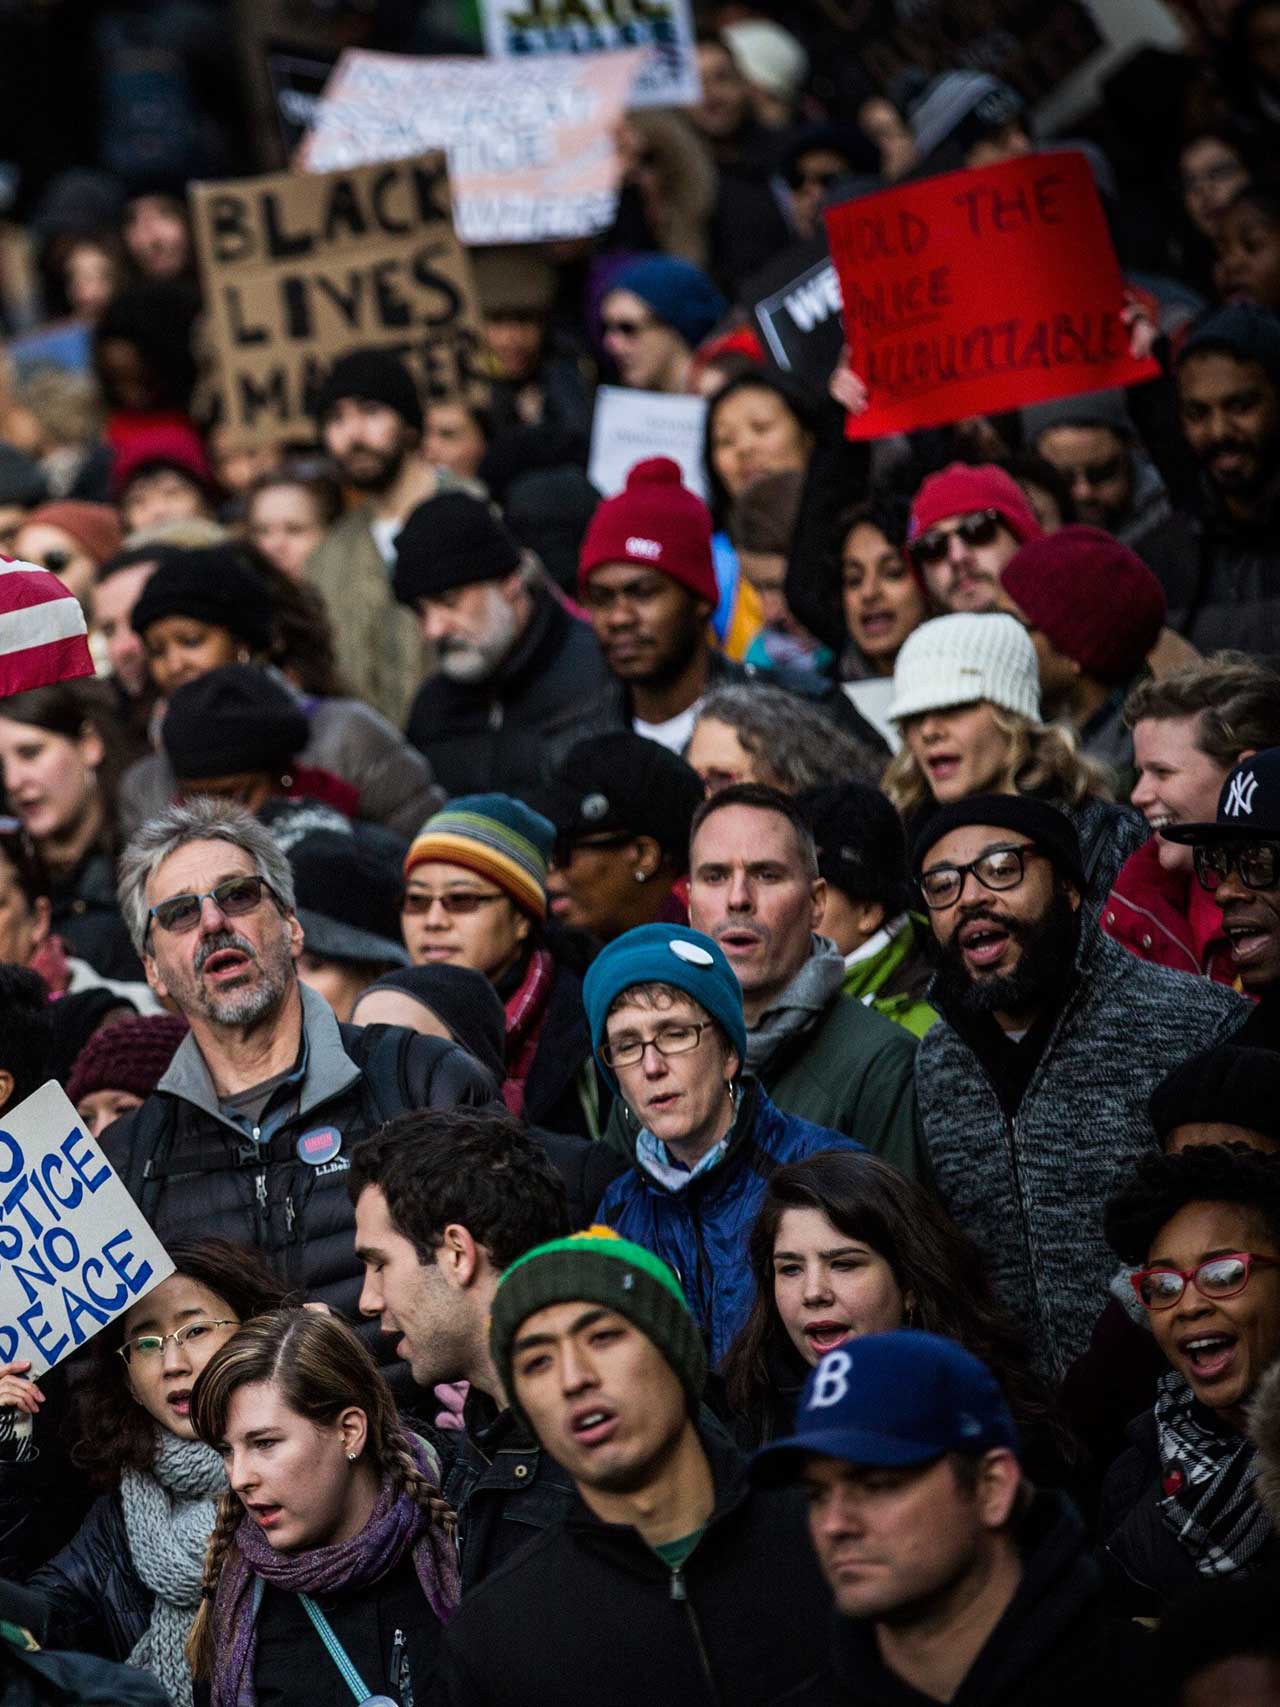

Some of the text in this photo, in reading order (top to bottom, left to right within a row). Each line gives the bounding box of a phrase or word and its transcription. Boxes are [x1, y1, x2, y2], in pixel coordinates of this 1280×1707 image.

[213, 162, 449, 262] BLACK
[953, 174, 1066, 234] THE
[225, 242, 461, 345] LIVES
[1224, 770, 1259, 817] NY
[11, 1226, 80, 1304] NO
[806, 1350, 853, 1411] B
